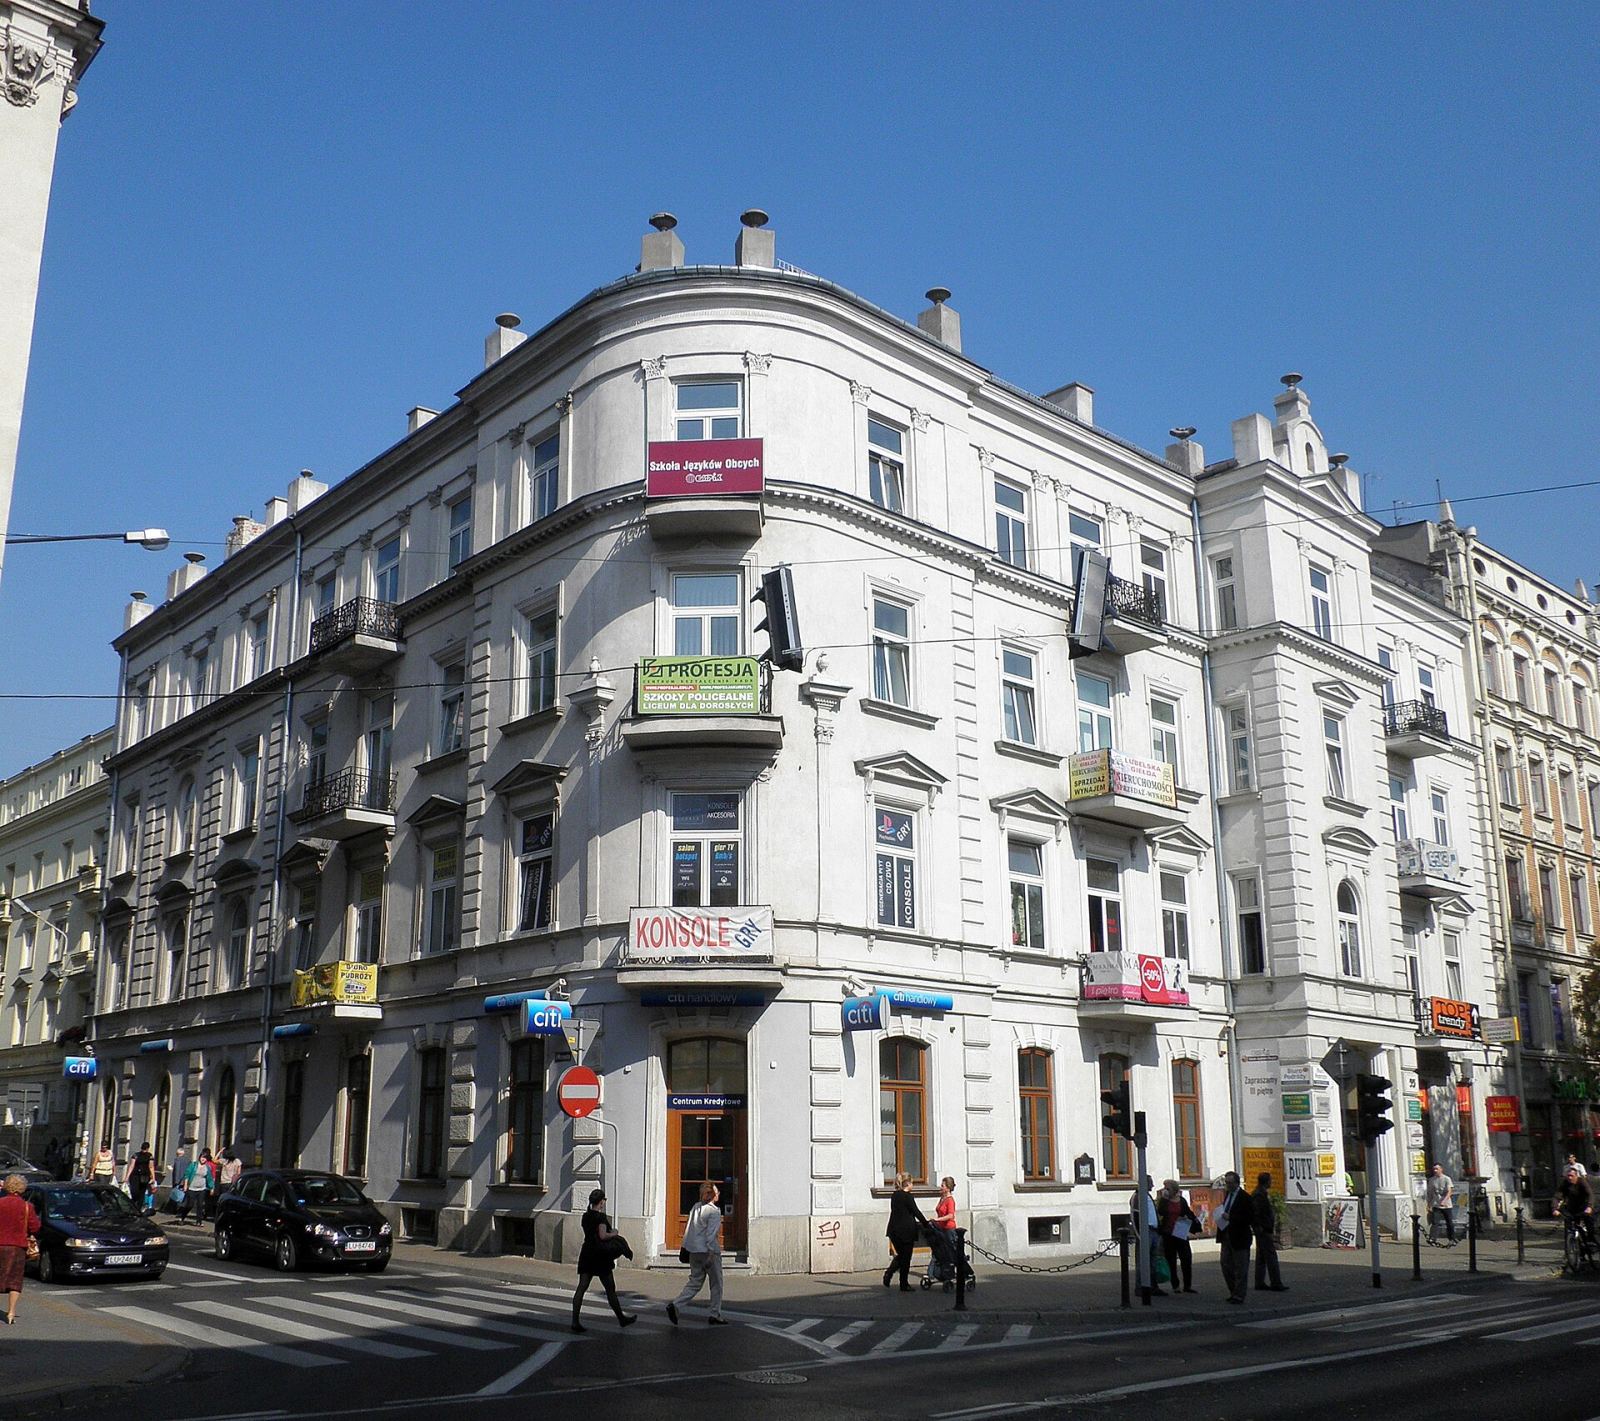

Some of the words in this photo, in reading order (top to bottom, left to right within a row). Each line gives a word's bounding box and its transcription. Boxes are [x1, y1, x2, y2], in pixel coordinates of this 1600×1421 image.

[649, 461, 680, 472] Szkoła
[683, 459, 722, 472] Języków
[725, 457, 759, 469] Obcych
[668, 663, 753, 677] PROFESJA
[643, 693, 685, 701] SZKOŁY
[688, 692, 753, 701] POLICEALNE
[1124, 757, 1161, 772] LUBELSKA
[1074, 775, 1105, 787] SPRZEDAŻ
[1074, 784, 1106, 796] WYNAJEM
[707, 811, 736, 819] AKCESORIA
[896, 820, 911, 842] GRY
[677, 843, 695, 852] salon
[714, 843, 725, 852] gier
[727, 843, 735, 851] TV
[675, 852, 698, 861] hotspot
[903, 864, 912, 924] KONSOLE
[637, 916, 731, 948] KONSOLE
[734, 918, 763, 949] GRY
[848, 1004, 873, 1024] citi
[1436, 1000, 1465, 1016] TOP
[533, 1008, 561, 1028] citi
[1438, 1014, 1467, 1029] trendy
[69, 1062, 90, 1074] citi
[672, 1097, 702, 1105] Centrum
[703, 1097, 741, 1106] Kredytowe
[1288, 1158, 1313, 1180] BUTY
